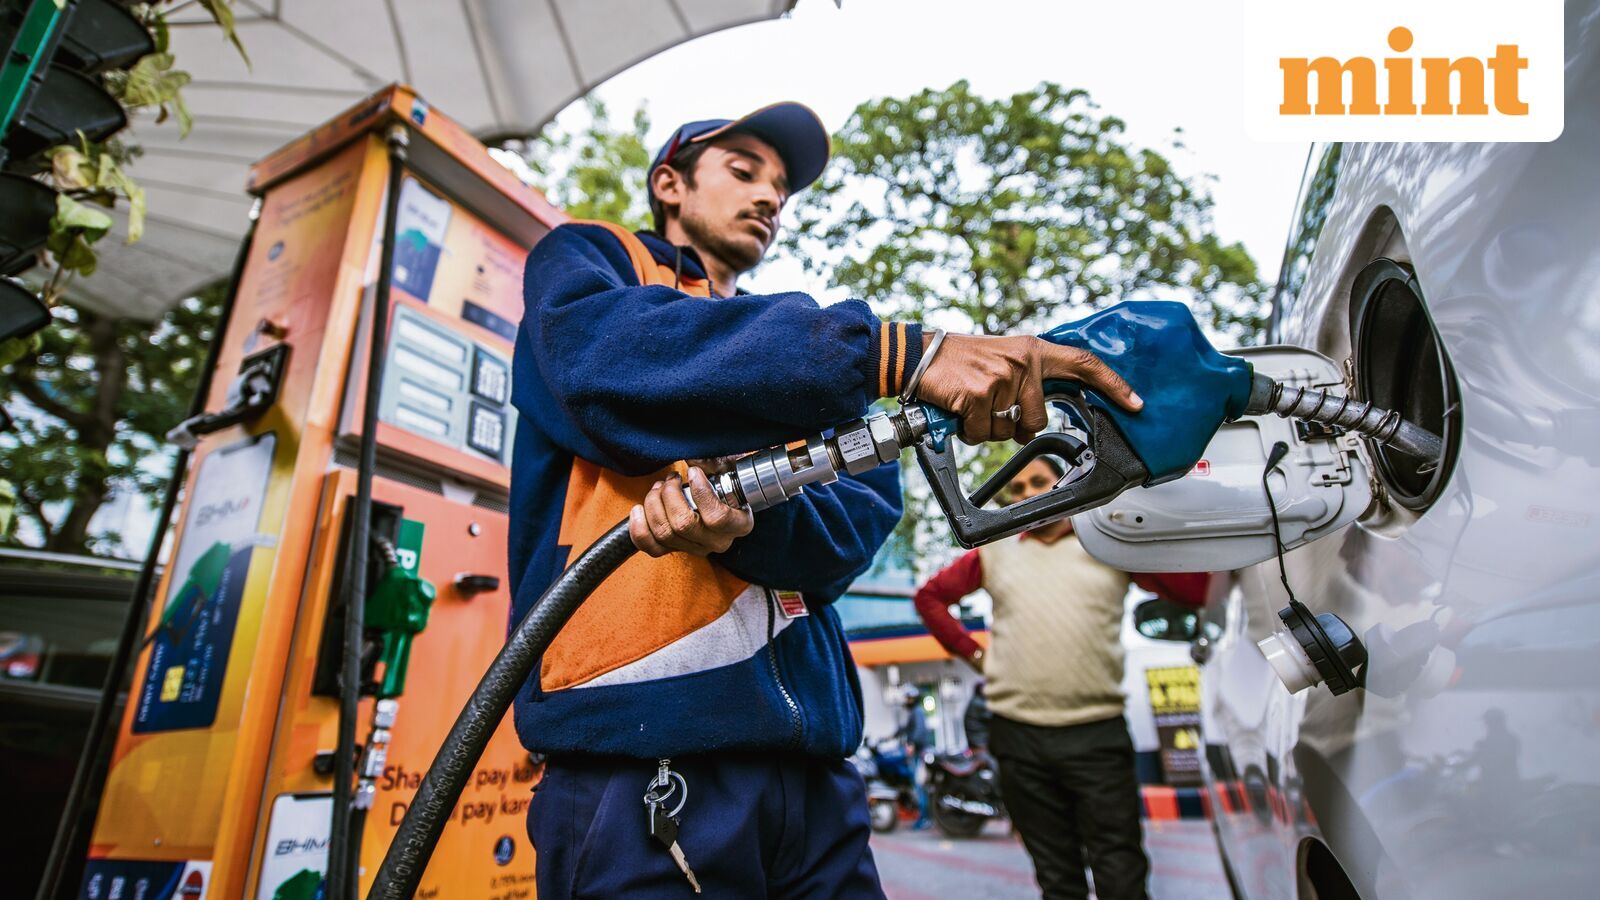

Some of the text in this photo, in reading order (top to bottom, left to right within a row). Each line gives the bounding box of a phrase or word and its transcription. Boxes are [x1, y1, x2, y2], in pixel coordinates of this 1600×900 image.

[461, 699, 495, 745] EXCEEDS
[453, 742, 470, 759] BS
[381, 766, 422, 791] Sha
[475, 768, 509, 790] pay
[461, 803, 497, 826] pay
[500, 794, 530, 815] kar
[408, 818, 432, 848] TYPE
